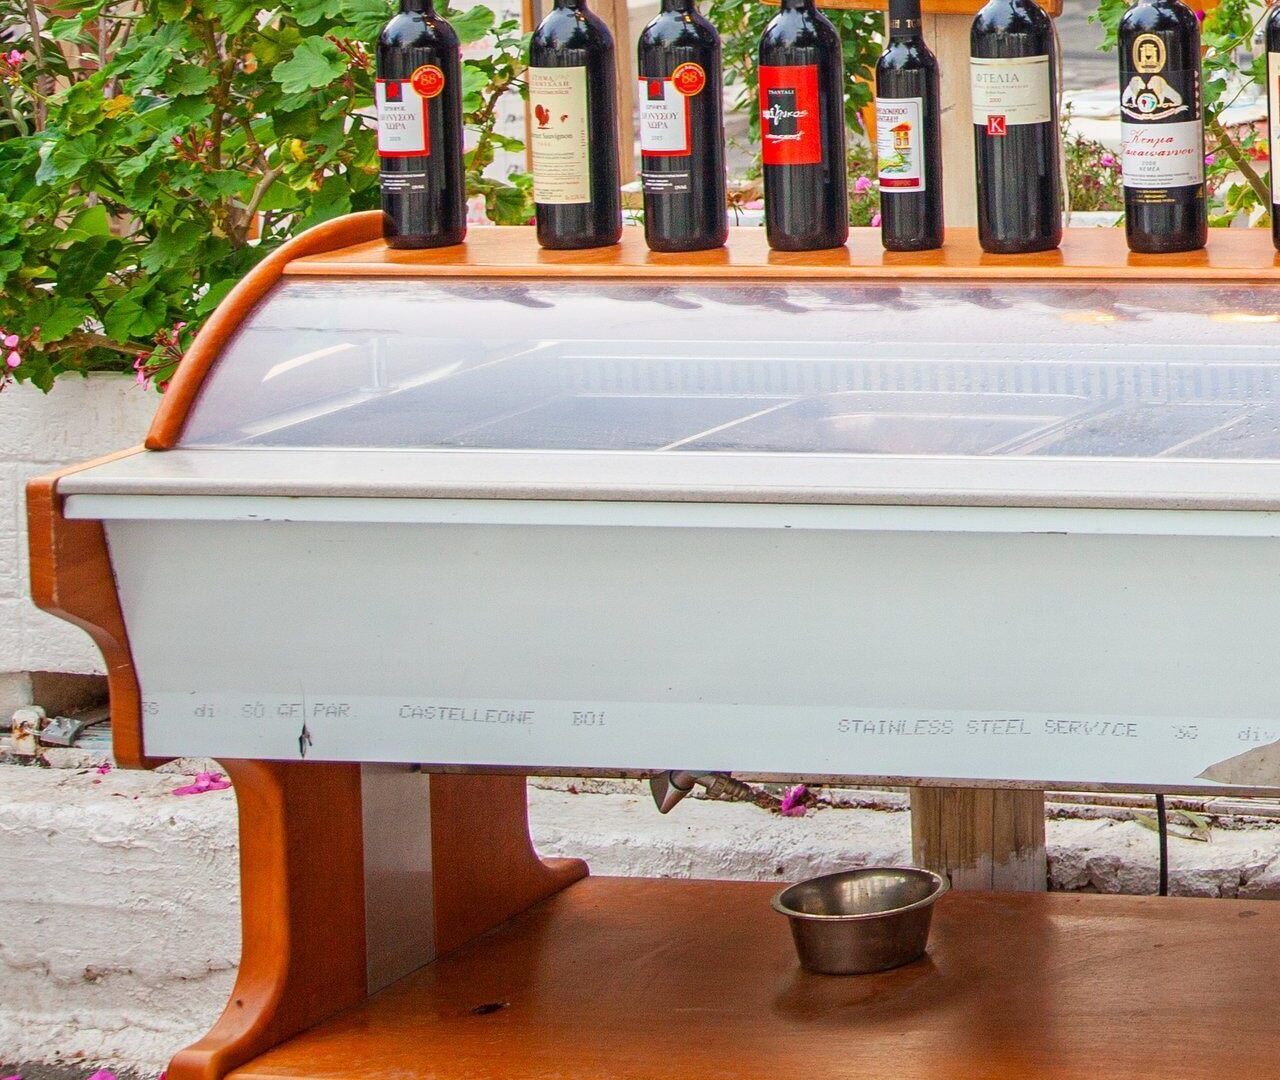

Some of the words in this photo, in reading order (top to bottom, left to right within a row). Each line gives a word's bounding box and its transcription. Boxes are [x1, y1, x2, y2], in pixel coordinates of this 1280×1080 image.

[420, 73, 437, 86] 88
[681, 72, 698, 84] 88
[399, 704, 536, 725] CASTELLEONE
[837, 718, 954, 737] STAINLESS
[965, 718, 1032, 736] STEEL
[1044, 719, 1138, 739] SERVICE
